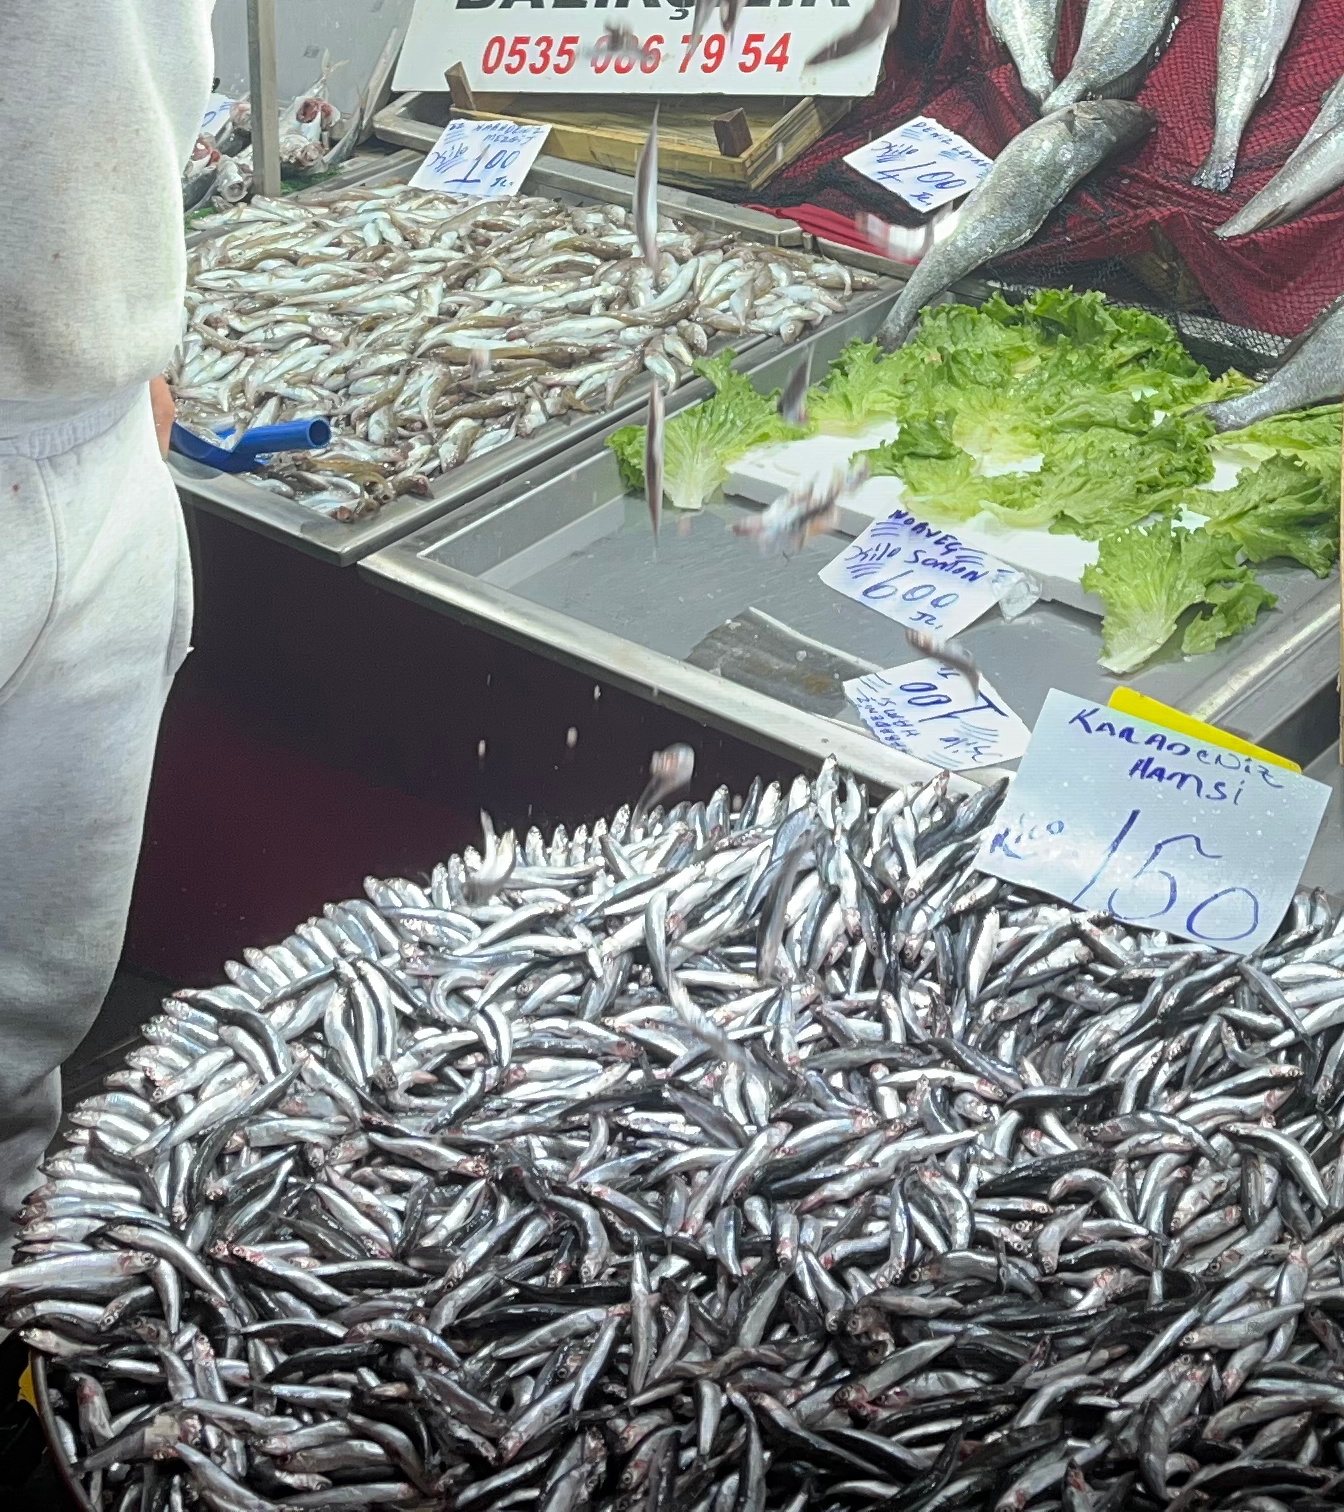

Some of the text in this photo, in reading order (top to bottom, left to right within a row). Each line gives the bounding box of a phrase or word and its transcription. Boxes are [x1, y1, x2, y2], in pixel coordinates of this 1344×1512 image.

[481, 34, 581, 75] 0535
[677, 33, 727, 74] 79
[738, 32, 792, 73] 54
[444, 143, 521, 184] 100
[861, 569, 960, 609] 600
[1071, 808, 1261, 942] 150
